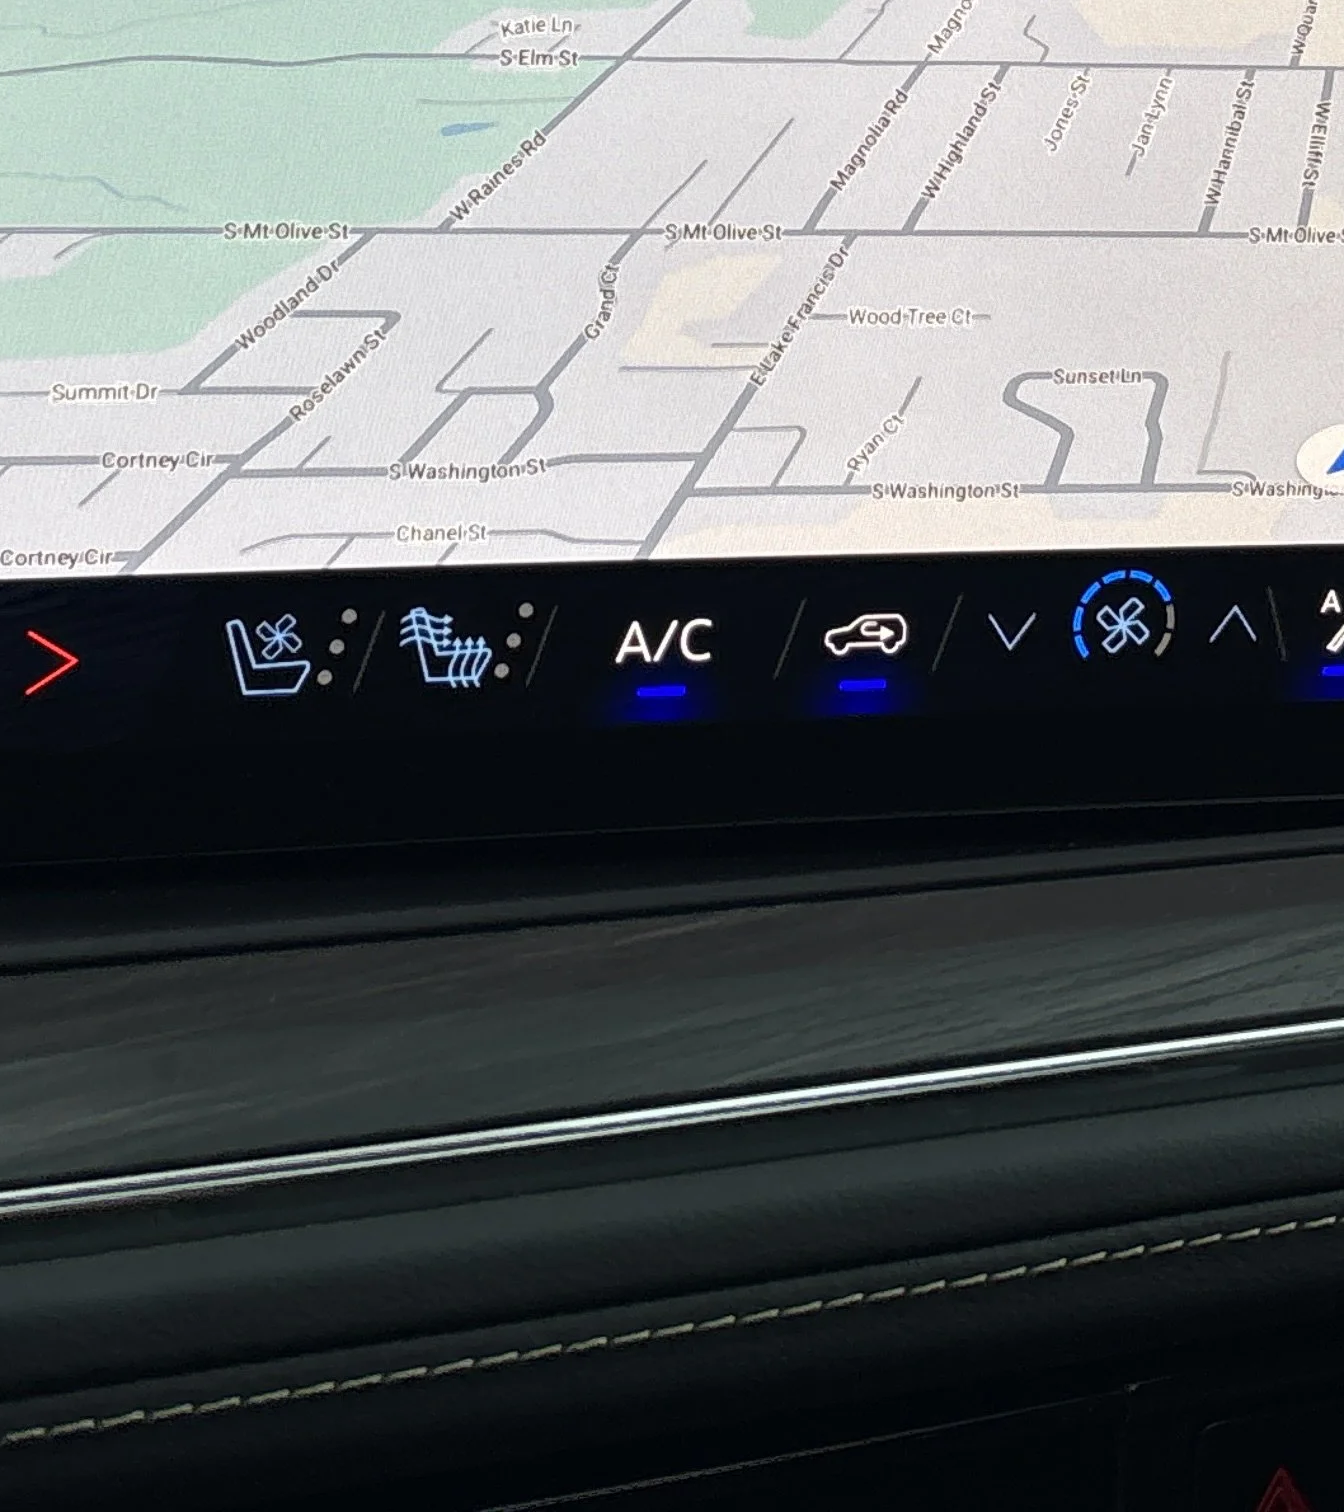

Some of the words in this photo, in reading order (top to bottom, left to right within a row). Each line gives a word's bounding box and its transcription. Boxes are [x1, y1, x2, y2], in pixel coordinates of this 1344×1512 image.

[501, 18, 546, 37] Katie
[551, 17, 573, 35] Ln
[500, 50, 512, 66] S
[518, 50, 553, 66] Elm
[559, 50, 579, 67] St
[829, 113, 890, 191] Magnolia
[883, 89, 907, 116] Rd
[449, 201, 471, 221] W
[467, 155, 524, 204] Raines
[521, 131, 547, 157] Rd
[224, 223, 237, 239] S
[243, 222, 269, 239] Mt
[275, 222, 323, 239] Olive
[329, 223, 349, 240] St
[664, 224, 678, 241] S
[683, 224, 708, 240] Mt
[712, 223, 757, 241] Olive
[762, 224, 782, 241] St
[1249, 230, 1260, 244] S
[1265, 229, 1289, 244] Mt
[1294, 229, 1336, 244] Olive
[235, 276, 319, 351] Woodland
[316, 258, 341, 283] Dr
[584, 284, 616, 342] Grand
[600, 263, 620, 285] Ct
[750, 372, 766, 387] E
[761, 328, 796, 372] Lake
[789, 268, 836, 331] Francis
[828, 245, 850, 268] Dr
[849, 308, 901, 325] Wood
[908, 308, 946, 325] Tree
[951, 308, 971, 325] Ct
[288, 345, 365, 422] Roselawn
[363, 327, 387, 351] St
[1053, 368, 1116, 384] Sunset
[1121, 368, 1142, 384] Ln
[52, 384, 128, 400] Summit
[136, 383, 159, 400] Dr
[847, 431, 885, 473] Ryan
[882, 413, 904, 437] Ct
[102, 451, 178, 472] Cortney
[185, 451, 213, 468] Cir
[389, 463, 402, 480] S
[408, 463, 521, 483] Washington
[525, 457, 547, 476] St
[872, 483, 884, 498] S
[889, 483, 997, 502] Washington
[1001, 483, 1020, 498] St
[396, 525, 463, 542] Chanel
[468, 524, 487, 541] St
[0, 550, 76, 570] Cortney
[84, 548, 113, 566] Cir
[1319, 589, 1342, 614] A
[615, 618, 712, 663] A/C
